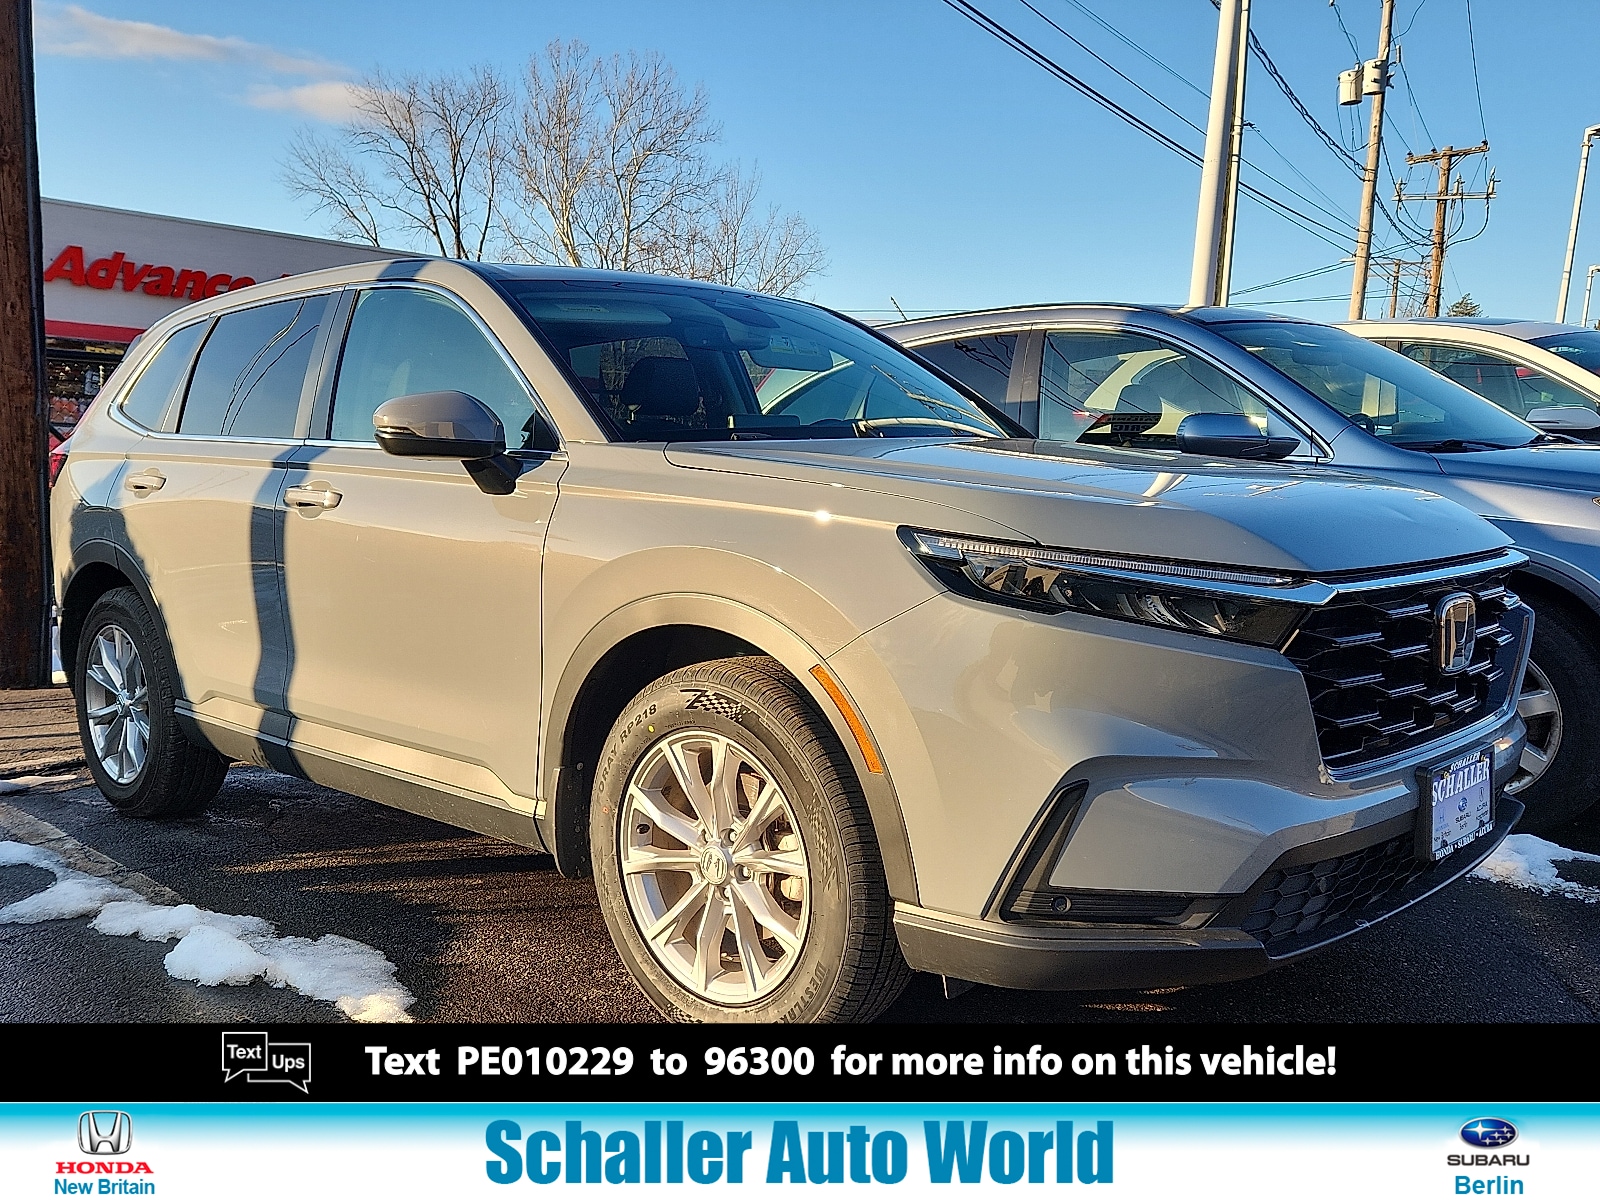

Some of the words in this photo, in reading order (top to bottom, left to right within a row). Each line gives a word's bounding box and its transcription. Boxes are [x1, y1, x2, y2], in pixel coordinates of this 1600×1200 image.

[619, 703, 657, 744] RP218
[1432, 758, 1490, 807] SCHALLER
[1449, 752, 1481, 773] SCHALLER
[1435, 844, 1455, 860] HONDA
[773, 960, 830, 1023] WESTLAK
